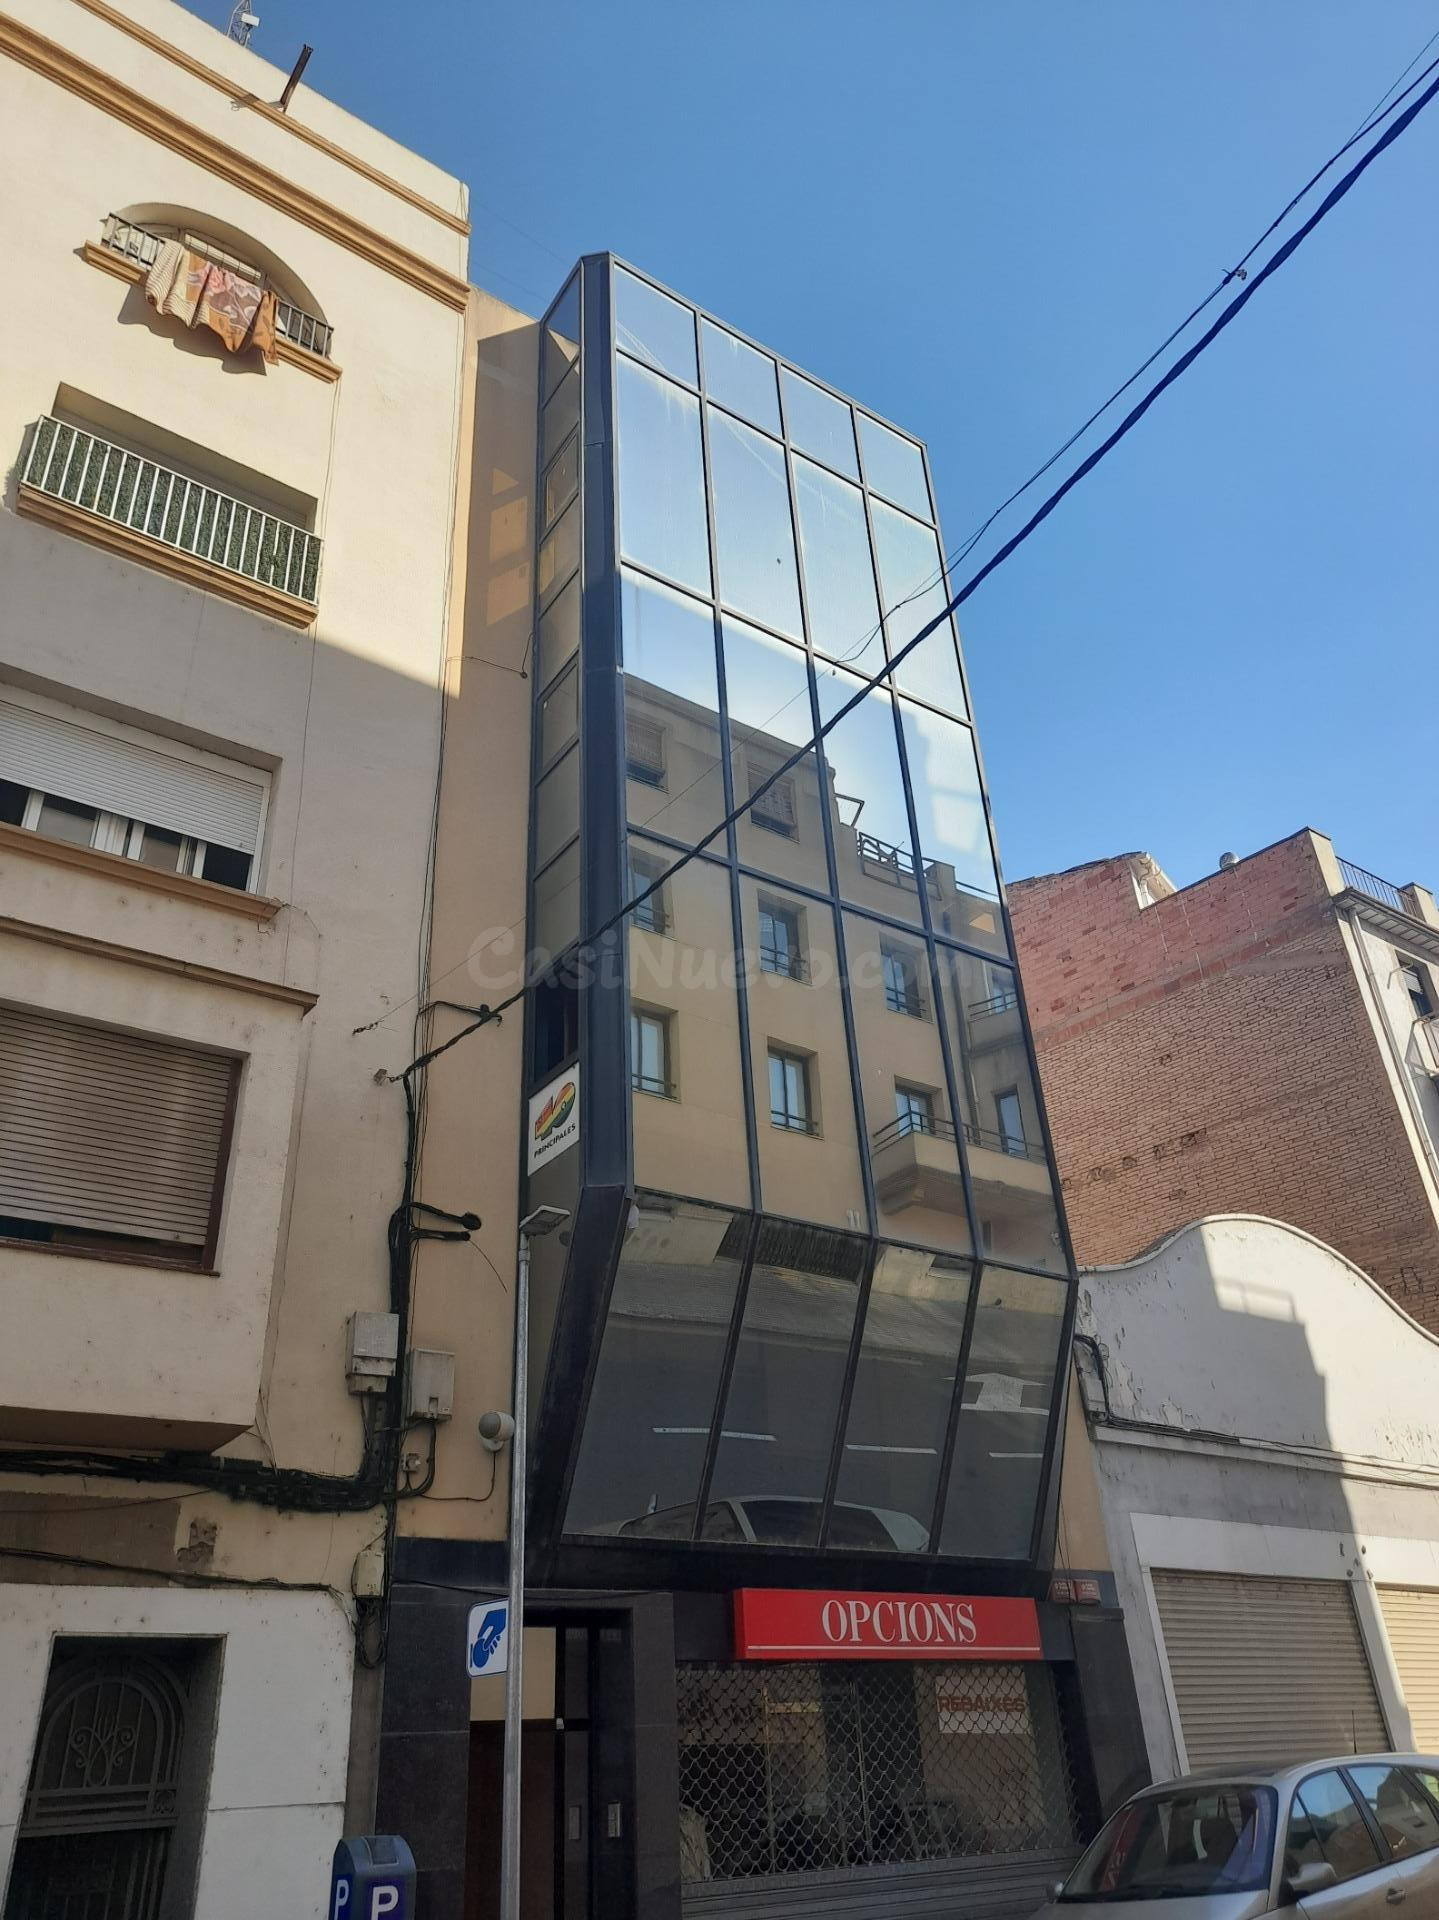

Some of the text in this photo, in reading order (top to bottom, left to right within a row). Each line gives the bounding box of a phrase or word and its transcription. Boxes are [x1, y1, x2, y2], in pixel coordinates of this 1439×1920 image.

[534, 1123, 576, 1158] PRINCIPALES
[822, 1600, 976, 1643] OPCIONS
[334, 1879, 349, 1920] P
[371, 1885, 399, 1920] P
